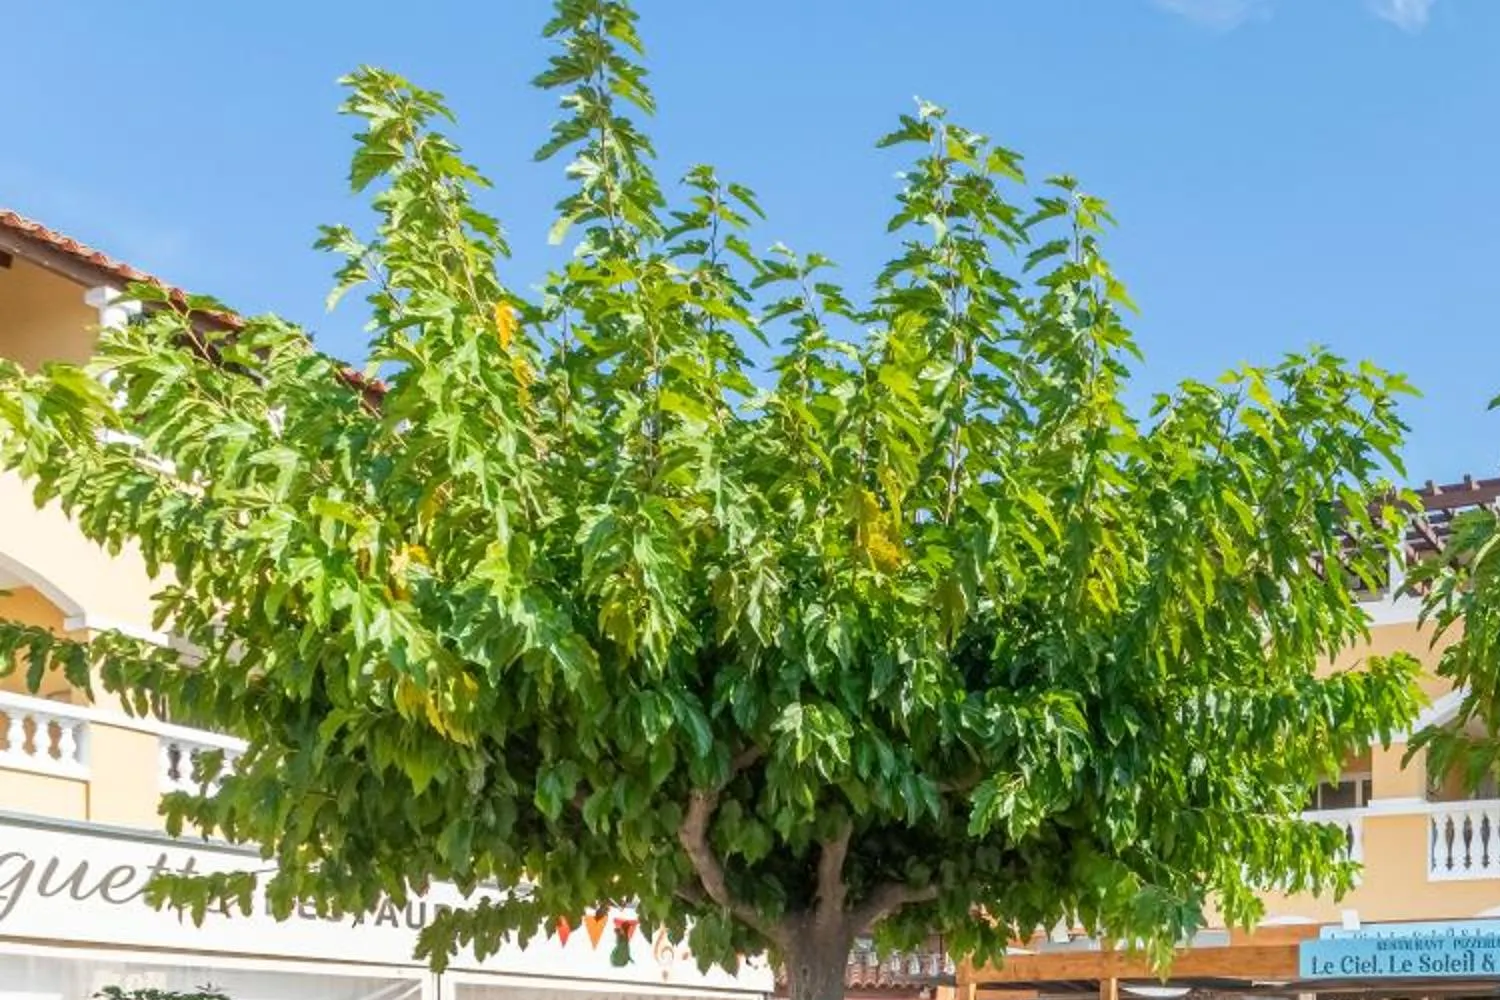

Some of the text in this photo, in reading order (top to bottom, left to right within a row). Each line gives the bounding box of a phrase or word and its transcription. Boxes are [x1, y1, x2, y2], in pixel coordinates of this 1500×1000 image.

[1312, 956, 1334, 974] Le
[1389, 955, 1412, 972] Le
[1418, 950, 1476, 973] Soleil
[1481, 953, 1496, 972] &
